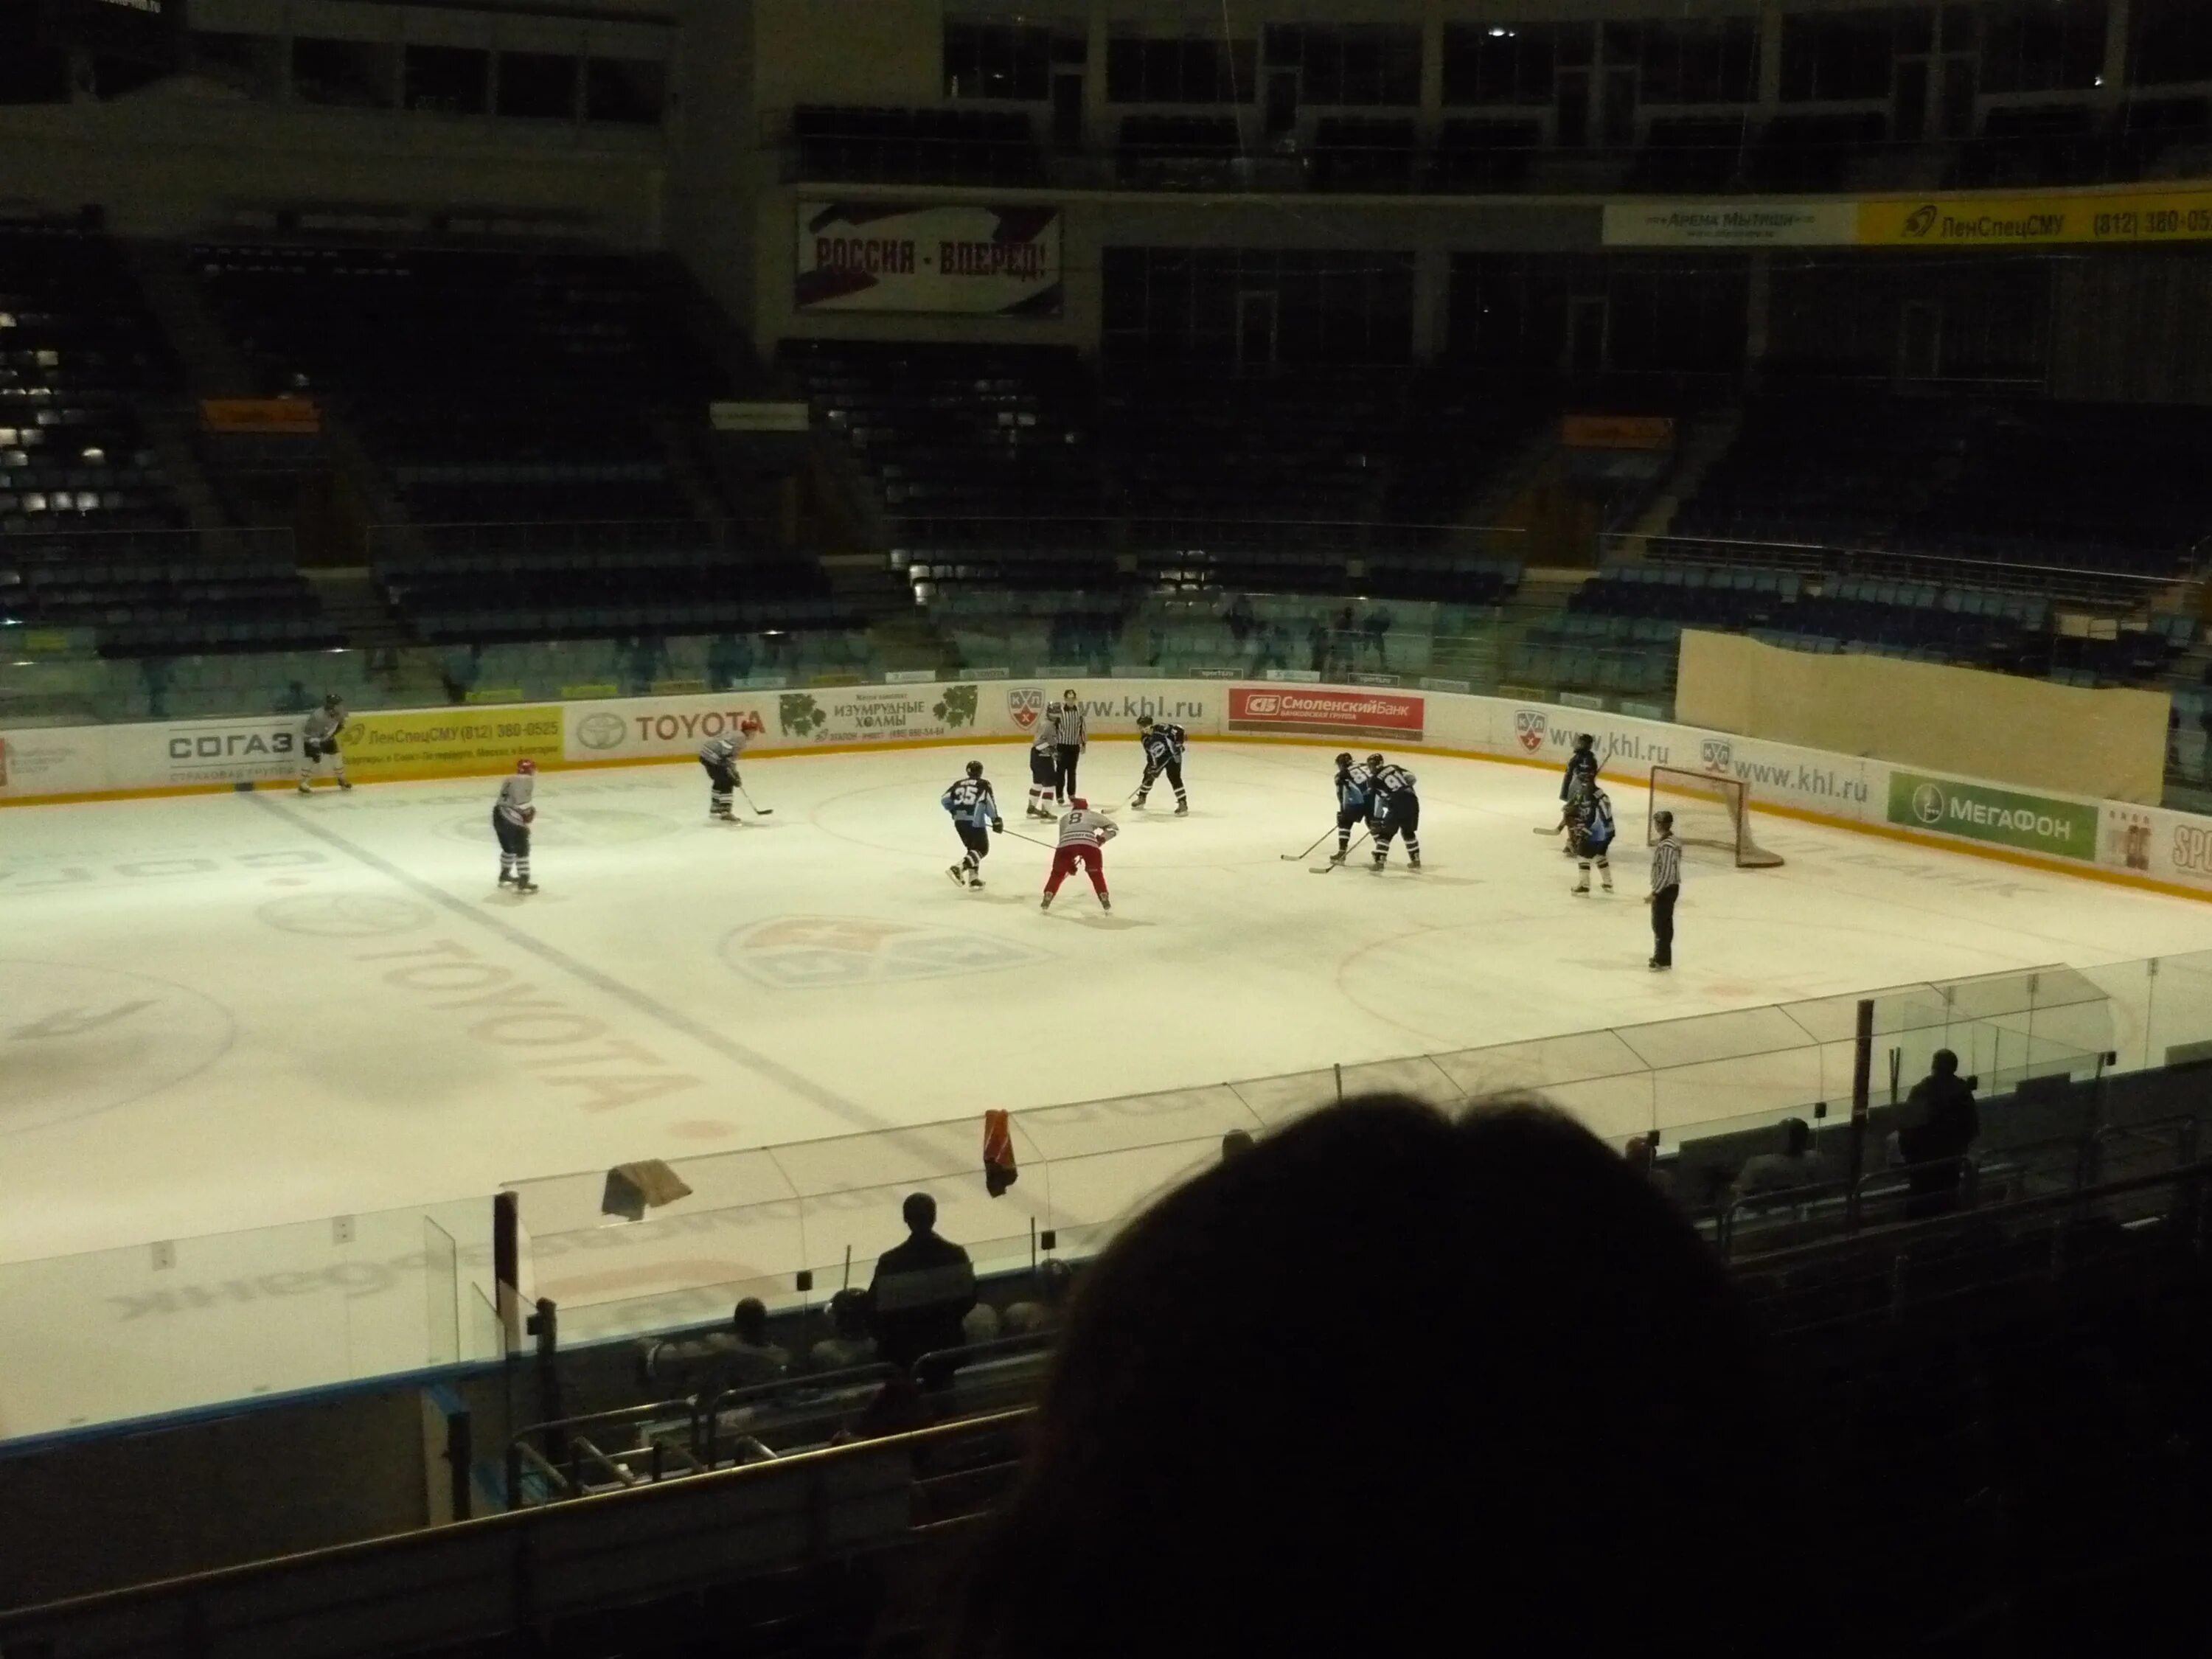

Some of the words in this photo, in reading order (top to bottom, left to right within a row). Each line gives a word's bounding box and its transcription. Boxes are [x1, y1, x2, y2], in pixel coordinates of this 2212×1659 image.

[2093, 210, 2138, 237] (812)
[816, 237, 915, 274] РОССИЯ
[834, 701, 925, 718] ИЗУМРУДНЫЕ
[855, 714, 906, 728] ХОЛМЫ
[636, 710, 766, 741] TOYOTA
[169, 732, 293, 759] СОГАЗ
[1734, 758, 1868, 804] www.khl.ru
[953, 786, 978, 805] 35
[1068, 812, 1082, 826] 8
[1949, 796, 2071, 841] МЕГАФОН
